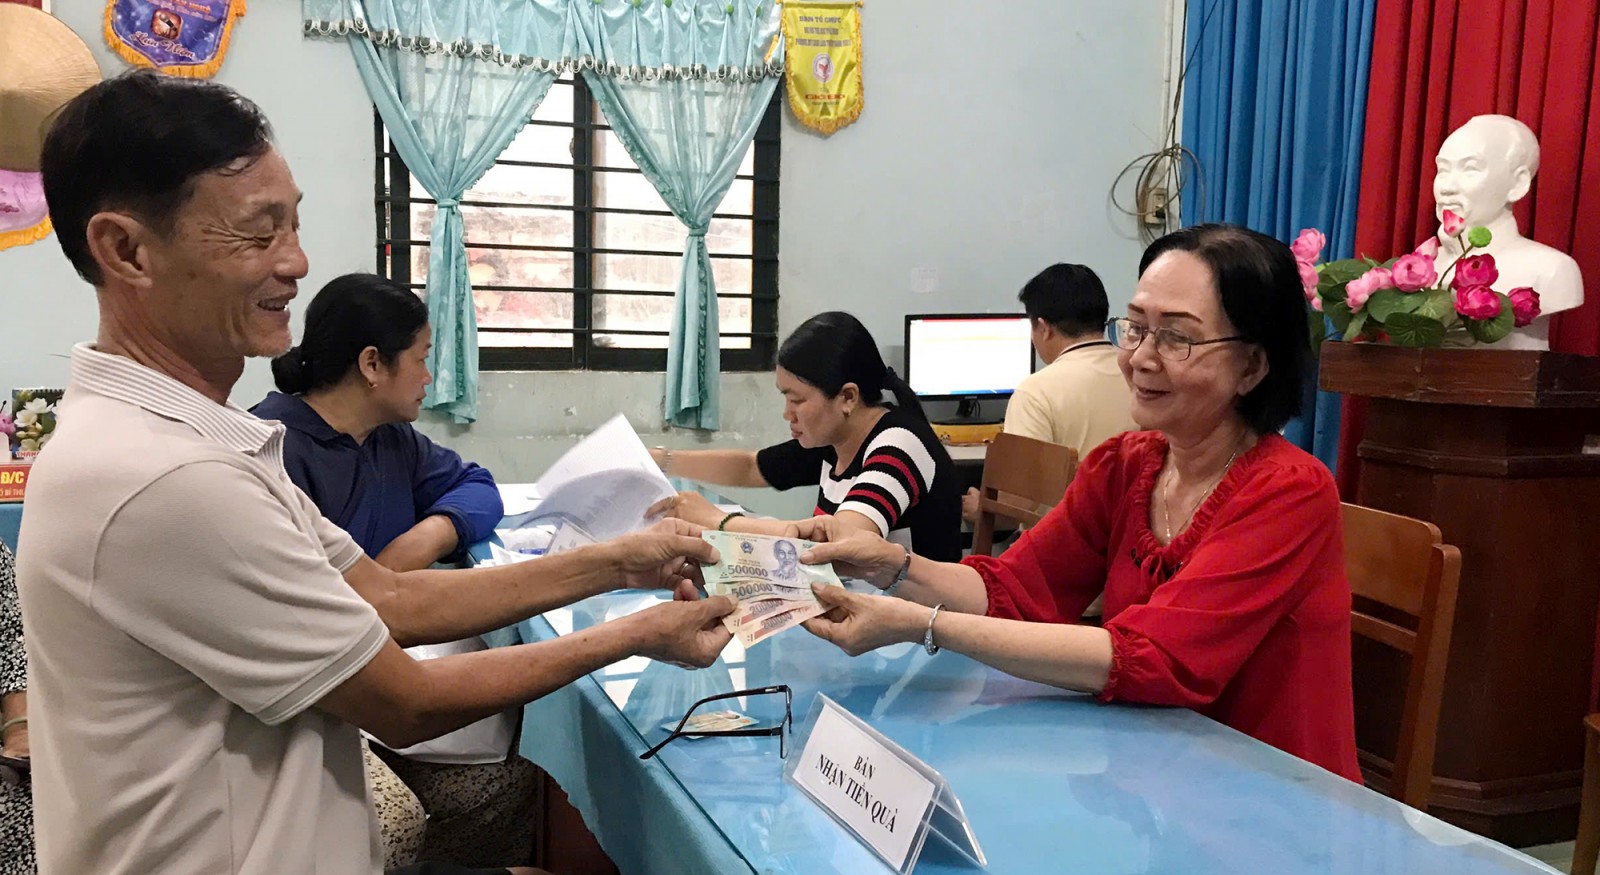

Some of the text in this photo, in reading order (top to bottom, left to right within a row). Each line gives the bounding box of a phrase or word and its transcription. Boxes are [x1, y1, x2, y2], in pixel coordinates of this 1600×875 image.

[728, 565, 768, 577] 500000
[731, 583, 773, 599] 500000
[815, 753, 847, 788] NHẬN
[871, 800, 898, 833] QUÀ
